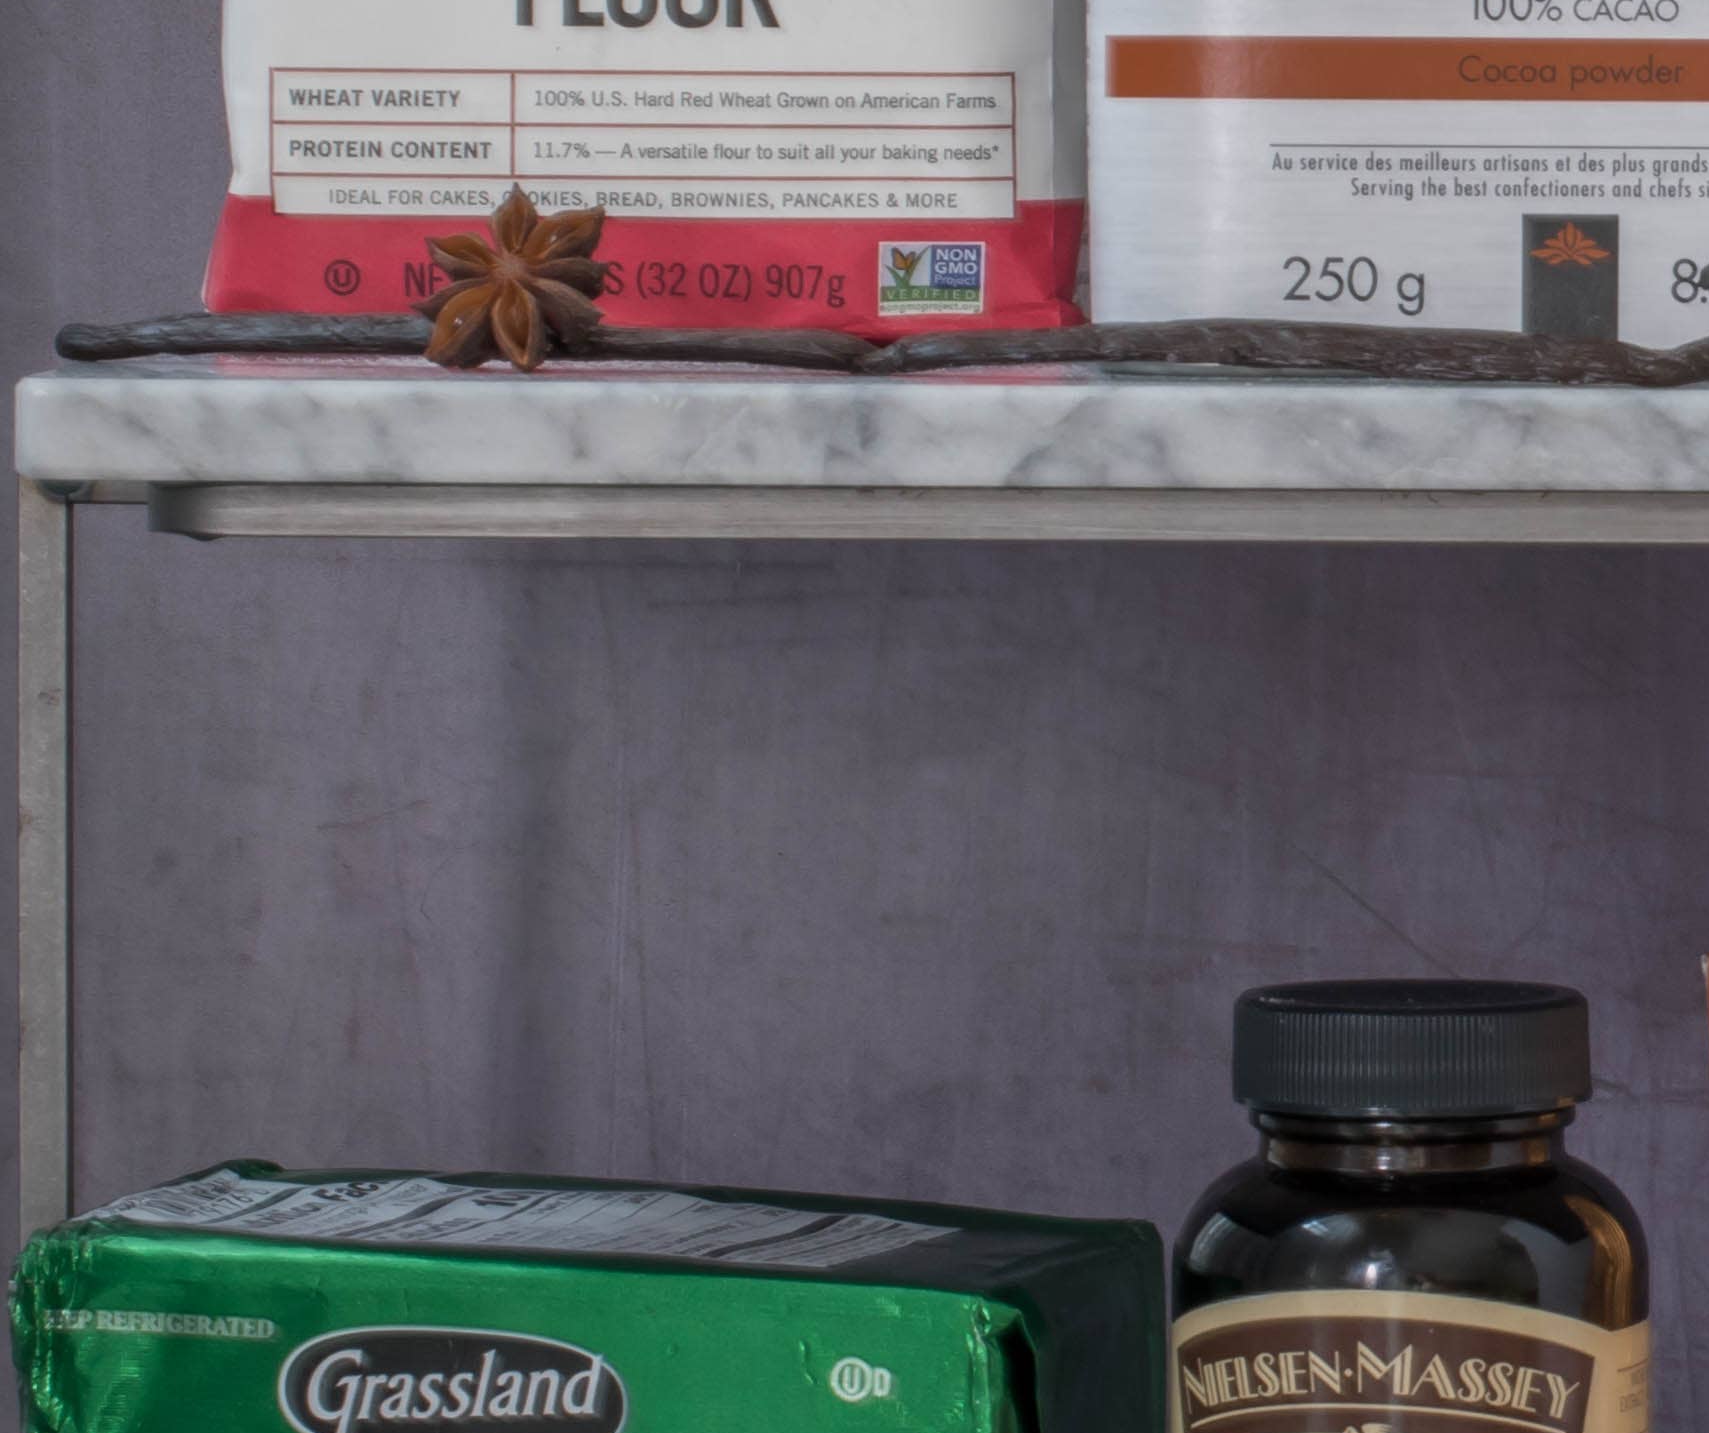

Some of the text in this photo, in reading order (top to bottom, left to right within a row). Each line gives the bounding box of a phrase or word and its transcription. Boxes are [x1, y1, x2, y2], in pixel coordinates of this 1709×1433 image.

[1458, 54, 1684, 92] Cocoa powder
[289, 88, 997, 110] WHEAT VARIETY 100% Hard Red Wheat Grown American Farms
[289, 140, 938, 165] PROTEIN CONTENT 11.7% versatile your baking
[1300, 153, 1358, 171] service
[1365, 151, 1392, 171] des
[1400, 152, 1476, 171] meilleurs
[1483, 154, 1548, 172] artisans
[1578, 152, 1605, 173] des
[1612, 153, 1645, 176] plus
[1653, 153, 1708, 176] grands
[329, 189, 958, 209] IDEAL FOR CAKES, BROWNIES, PANCAKES MORE
[1351, 177, 1413, 200] Serving
[1454, 177, 1487, 197] best
[1494, 177, 1605, 198] confectioners
[1612, 179, 1642, 198] and
[1650, 179, 1692, 198] chefs
[637, 263, 686, 300] (32
[766, 264, 845, 308] 907g
[1283, 256, 1425, 316] 250 g
